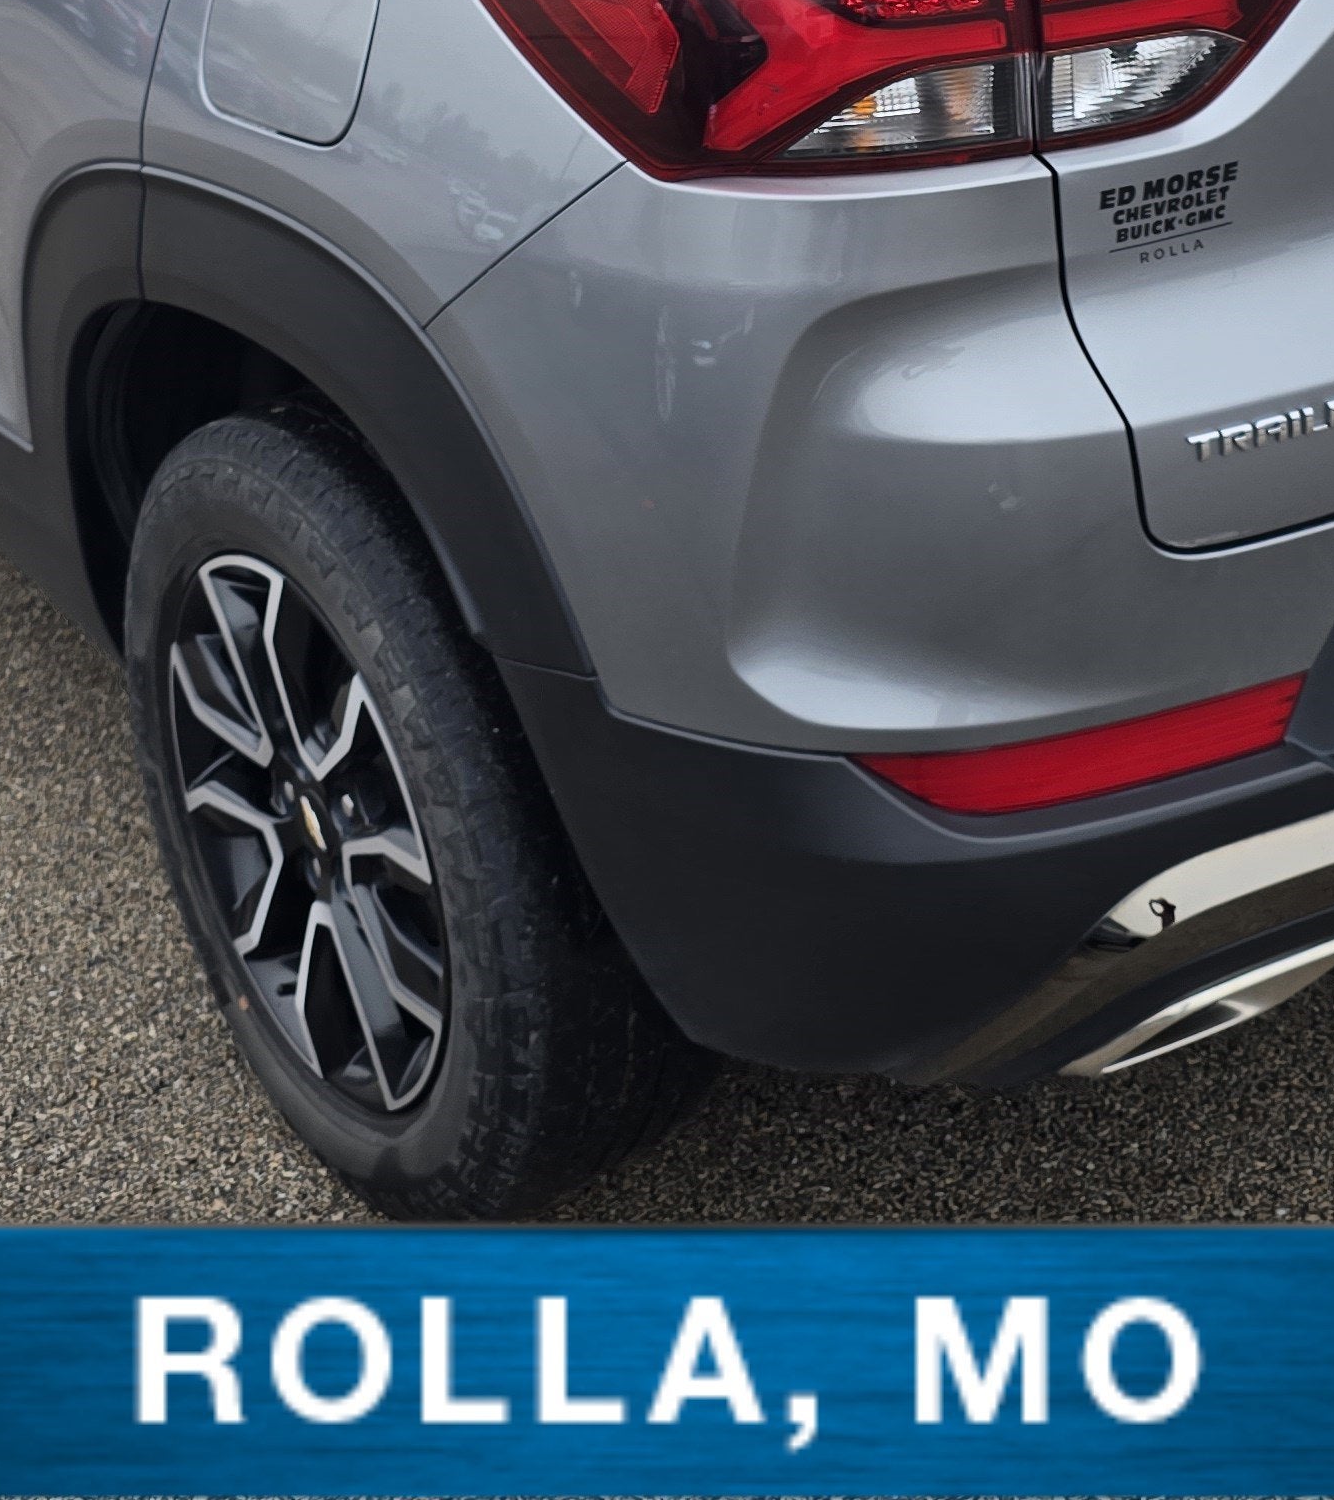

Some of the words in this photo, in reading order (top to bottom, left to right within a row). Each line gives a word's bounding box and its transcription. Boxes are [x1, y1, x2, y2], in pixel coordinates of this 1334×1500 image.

[1100, 185, 1135, 210] ED
[1143, 161, 1239, 201] MORSE
[1113, 185, 1230, 225] CHEVROLET
[1140, 239, 1204, 264] ROLLA
